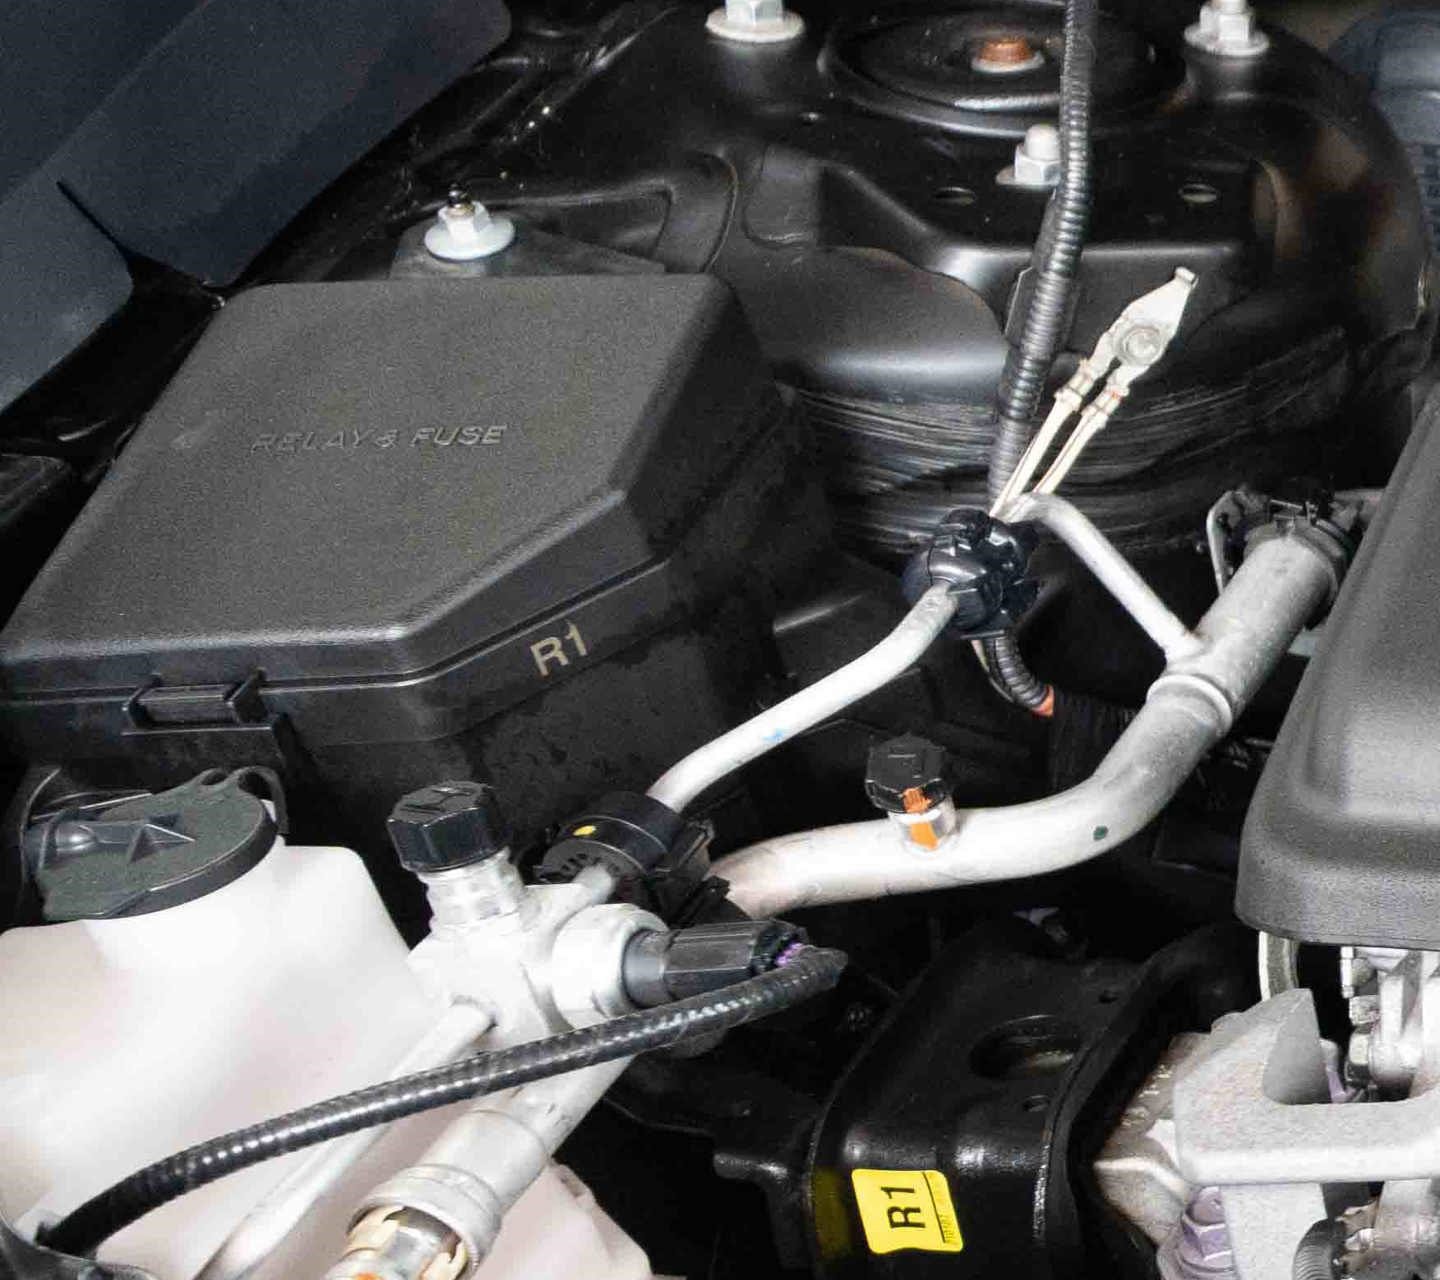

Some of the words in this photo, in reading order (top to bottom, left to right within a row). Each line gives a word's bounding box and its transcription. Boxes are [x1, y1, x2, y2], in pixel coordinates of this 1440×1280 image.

[251, 429, 374, 455] RELAY
[375, 428, 398, 448] &
[410, 422, 507, 448] FUSE
[530, 622, 587, 675] R1
[880, 1186, 925, 1228] R1
